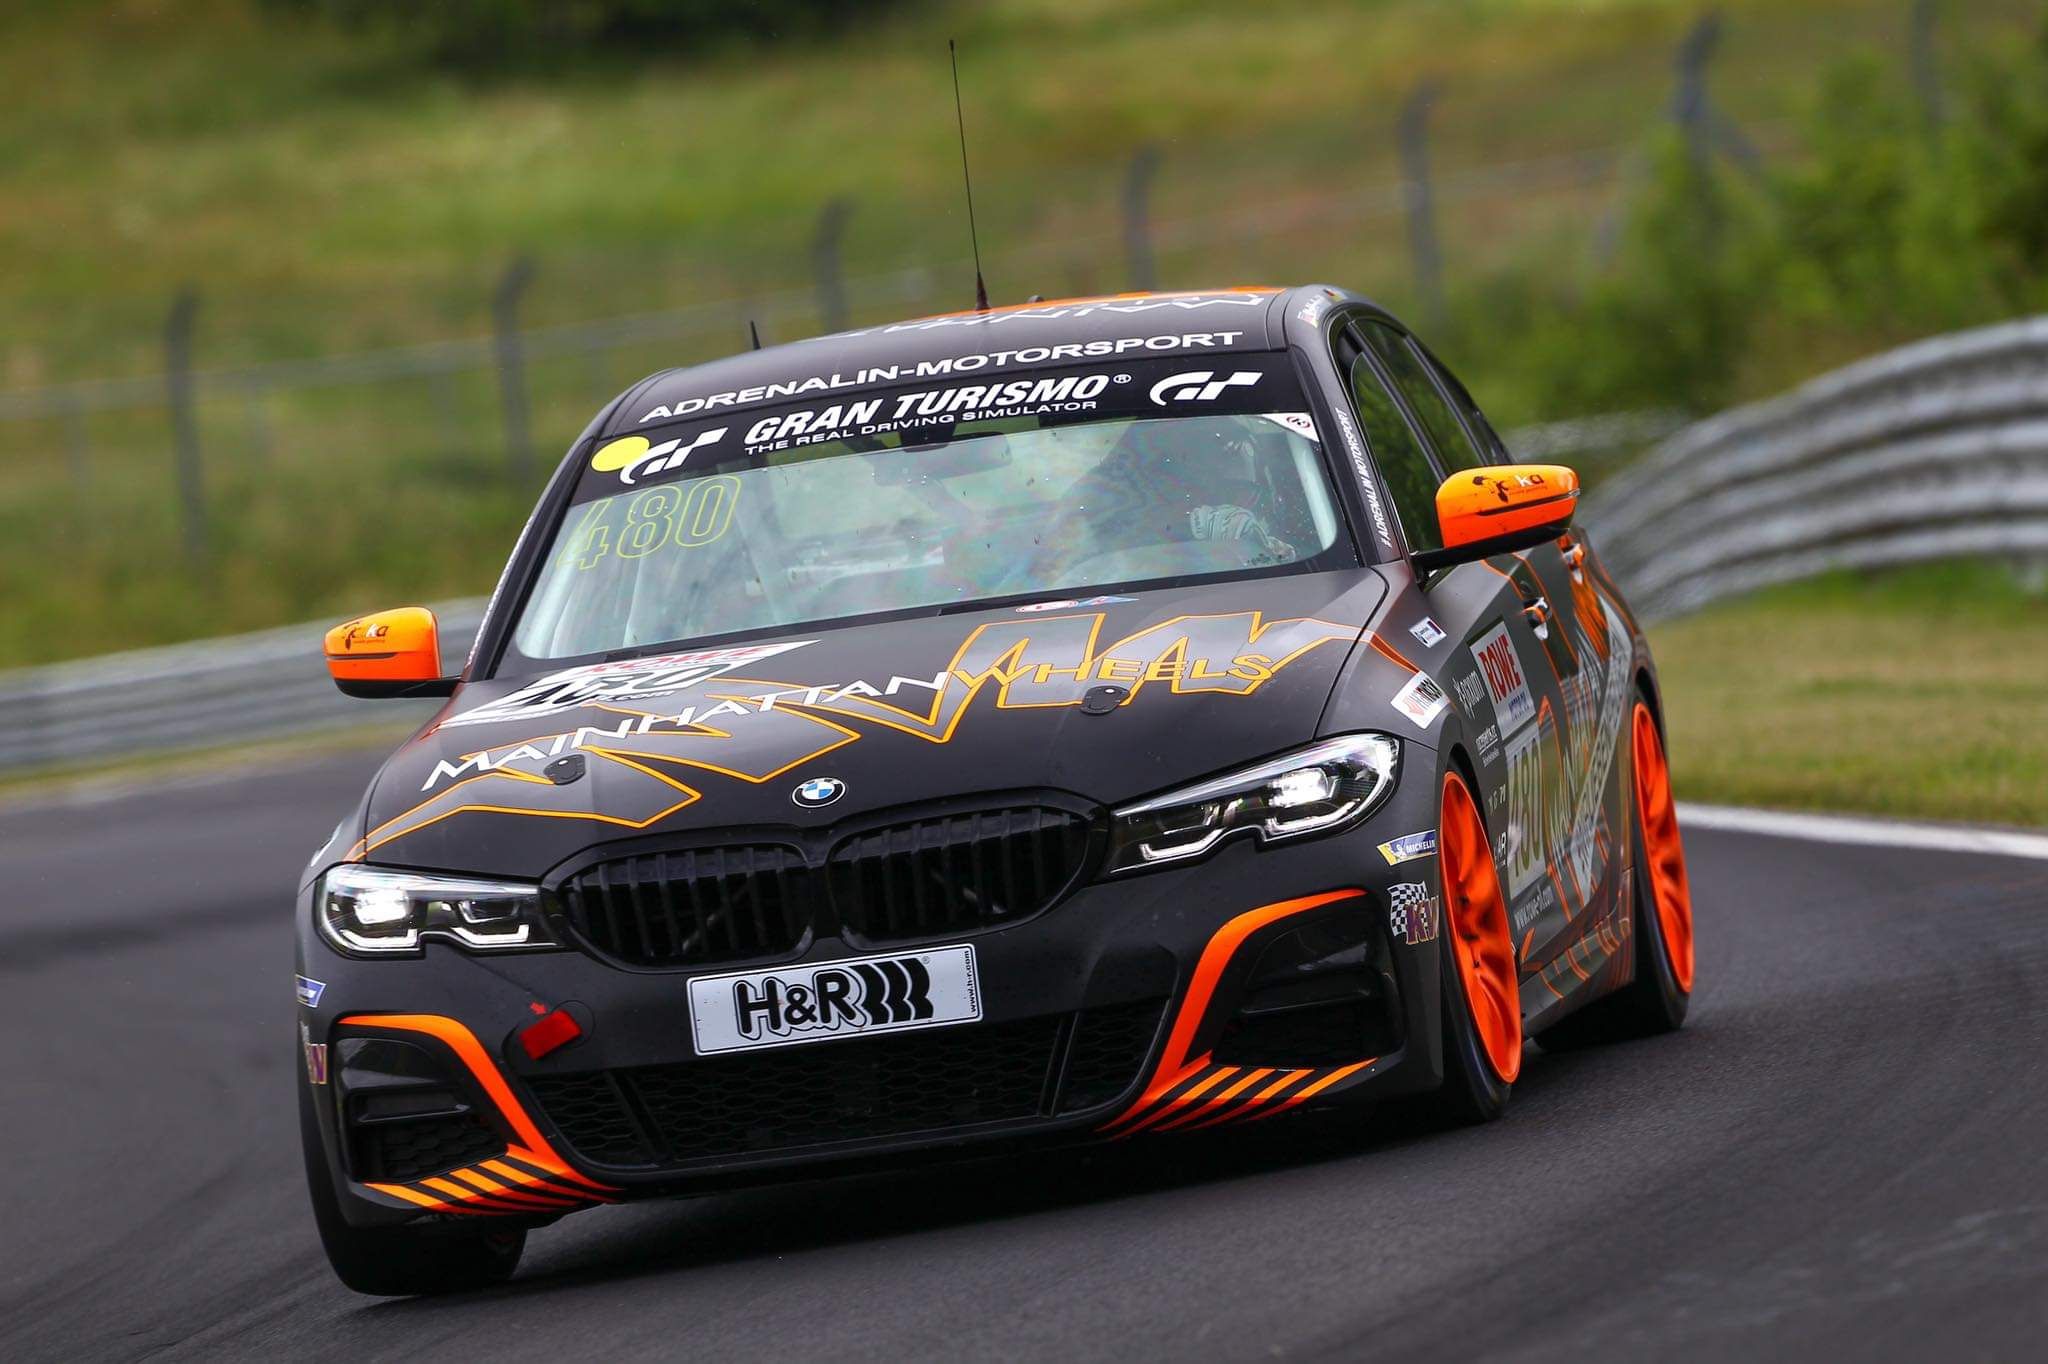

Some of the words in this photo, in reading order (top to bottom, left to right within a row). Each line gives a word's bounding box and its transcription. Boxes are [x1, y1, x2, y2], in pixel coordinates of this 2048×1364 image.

[639, 331, 1243, 423] ADRENALIN-MOTORSPORT
[744, 399, 884, 445] GRAN
[744, 440, 789, 456] THE
[796, 430, 855, 446] REAL
[861, 414, 955, 435] DRIVING
[962, 401, 1097, 422] SIMULATOR
[556, 475, 742, 571] 480
[1478, 633, 1521, 704] ROWE
[420, 670, 949, 792] MAINHATTAN
[950, 653, 1274, 688] WHEELS
[733, 967, 867, 1041] H&R
